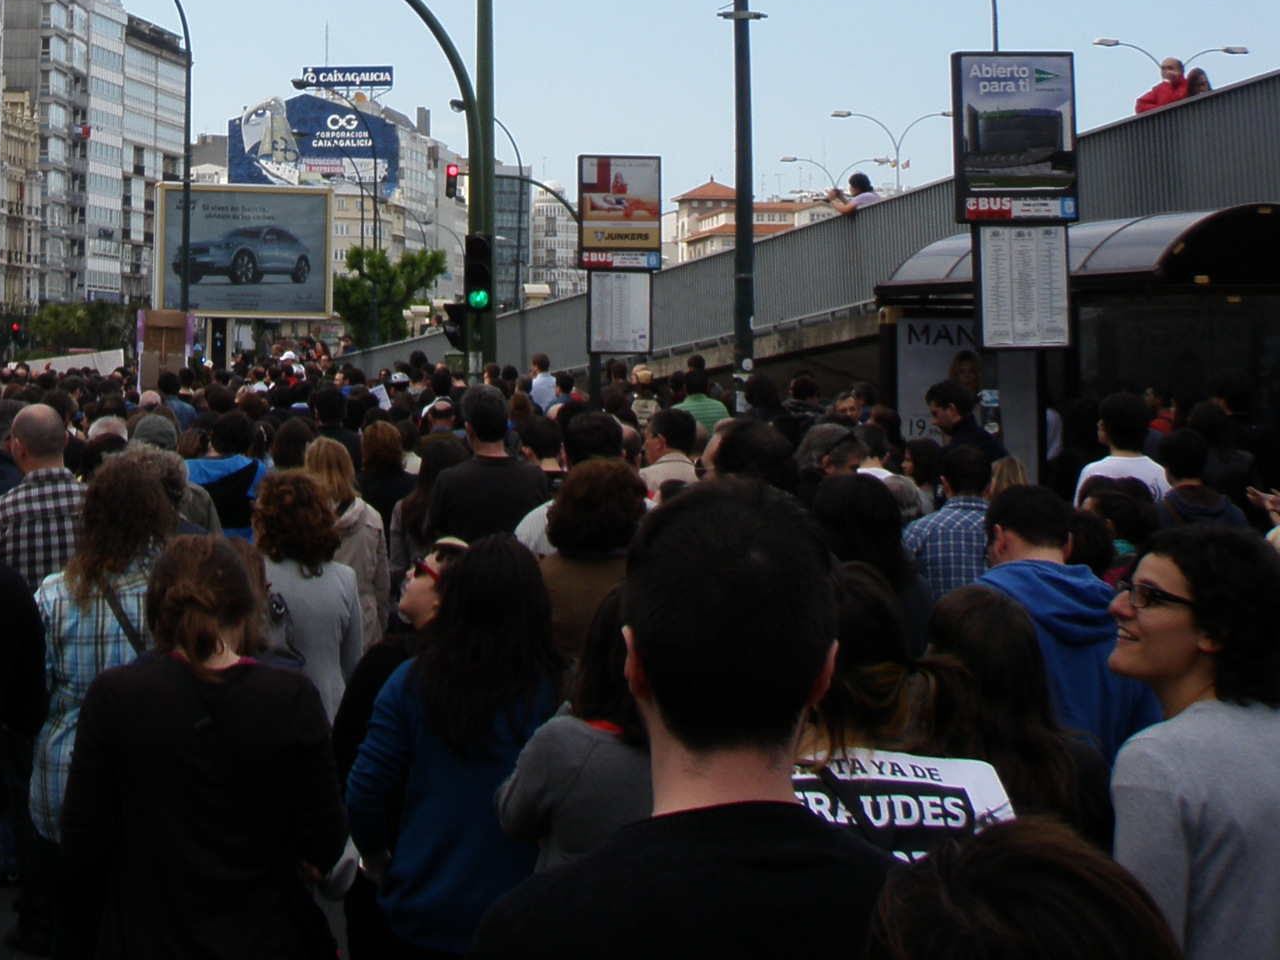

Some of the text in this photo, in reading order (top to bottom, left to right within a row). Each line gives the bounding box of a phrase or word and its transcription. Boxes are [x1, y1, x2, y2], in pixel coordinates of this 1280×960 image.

[969, 63, 1030, 78] Abierto
[979, 78, 1030, 95] para ti
[604, 231, 650, 241] JUNKERS
[870, 760, 908, 778] YA
[909, 764, 944, 782] DE
